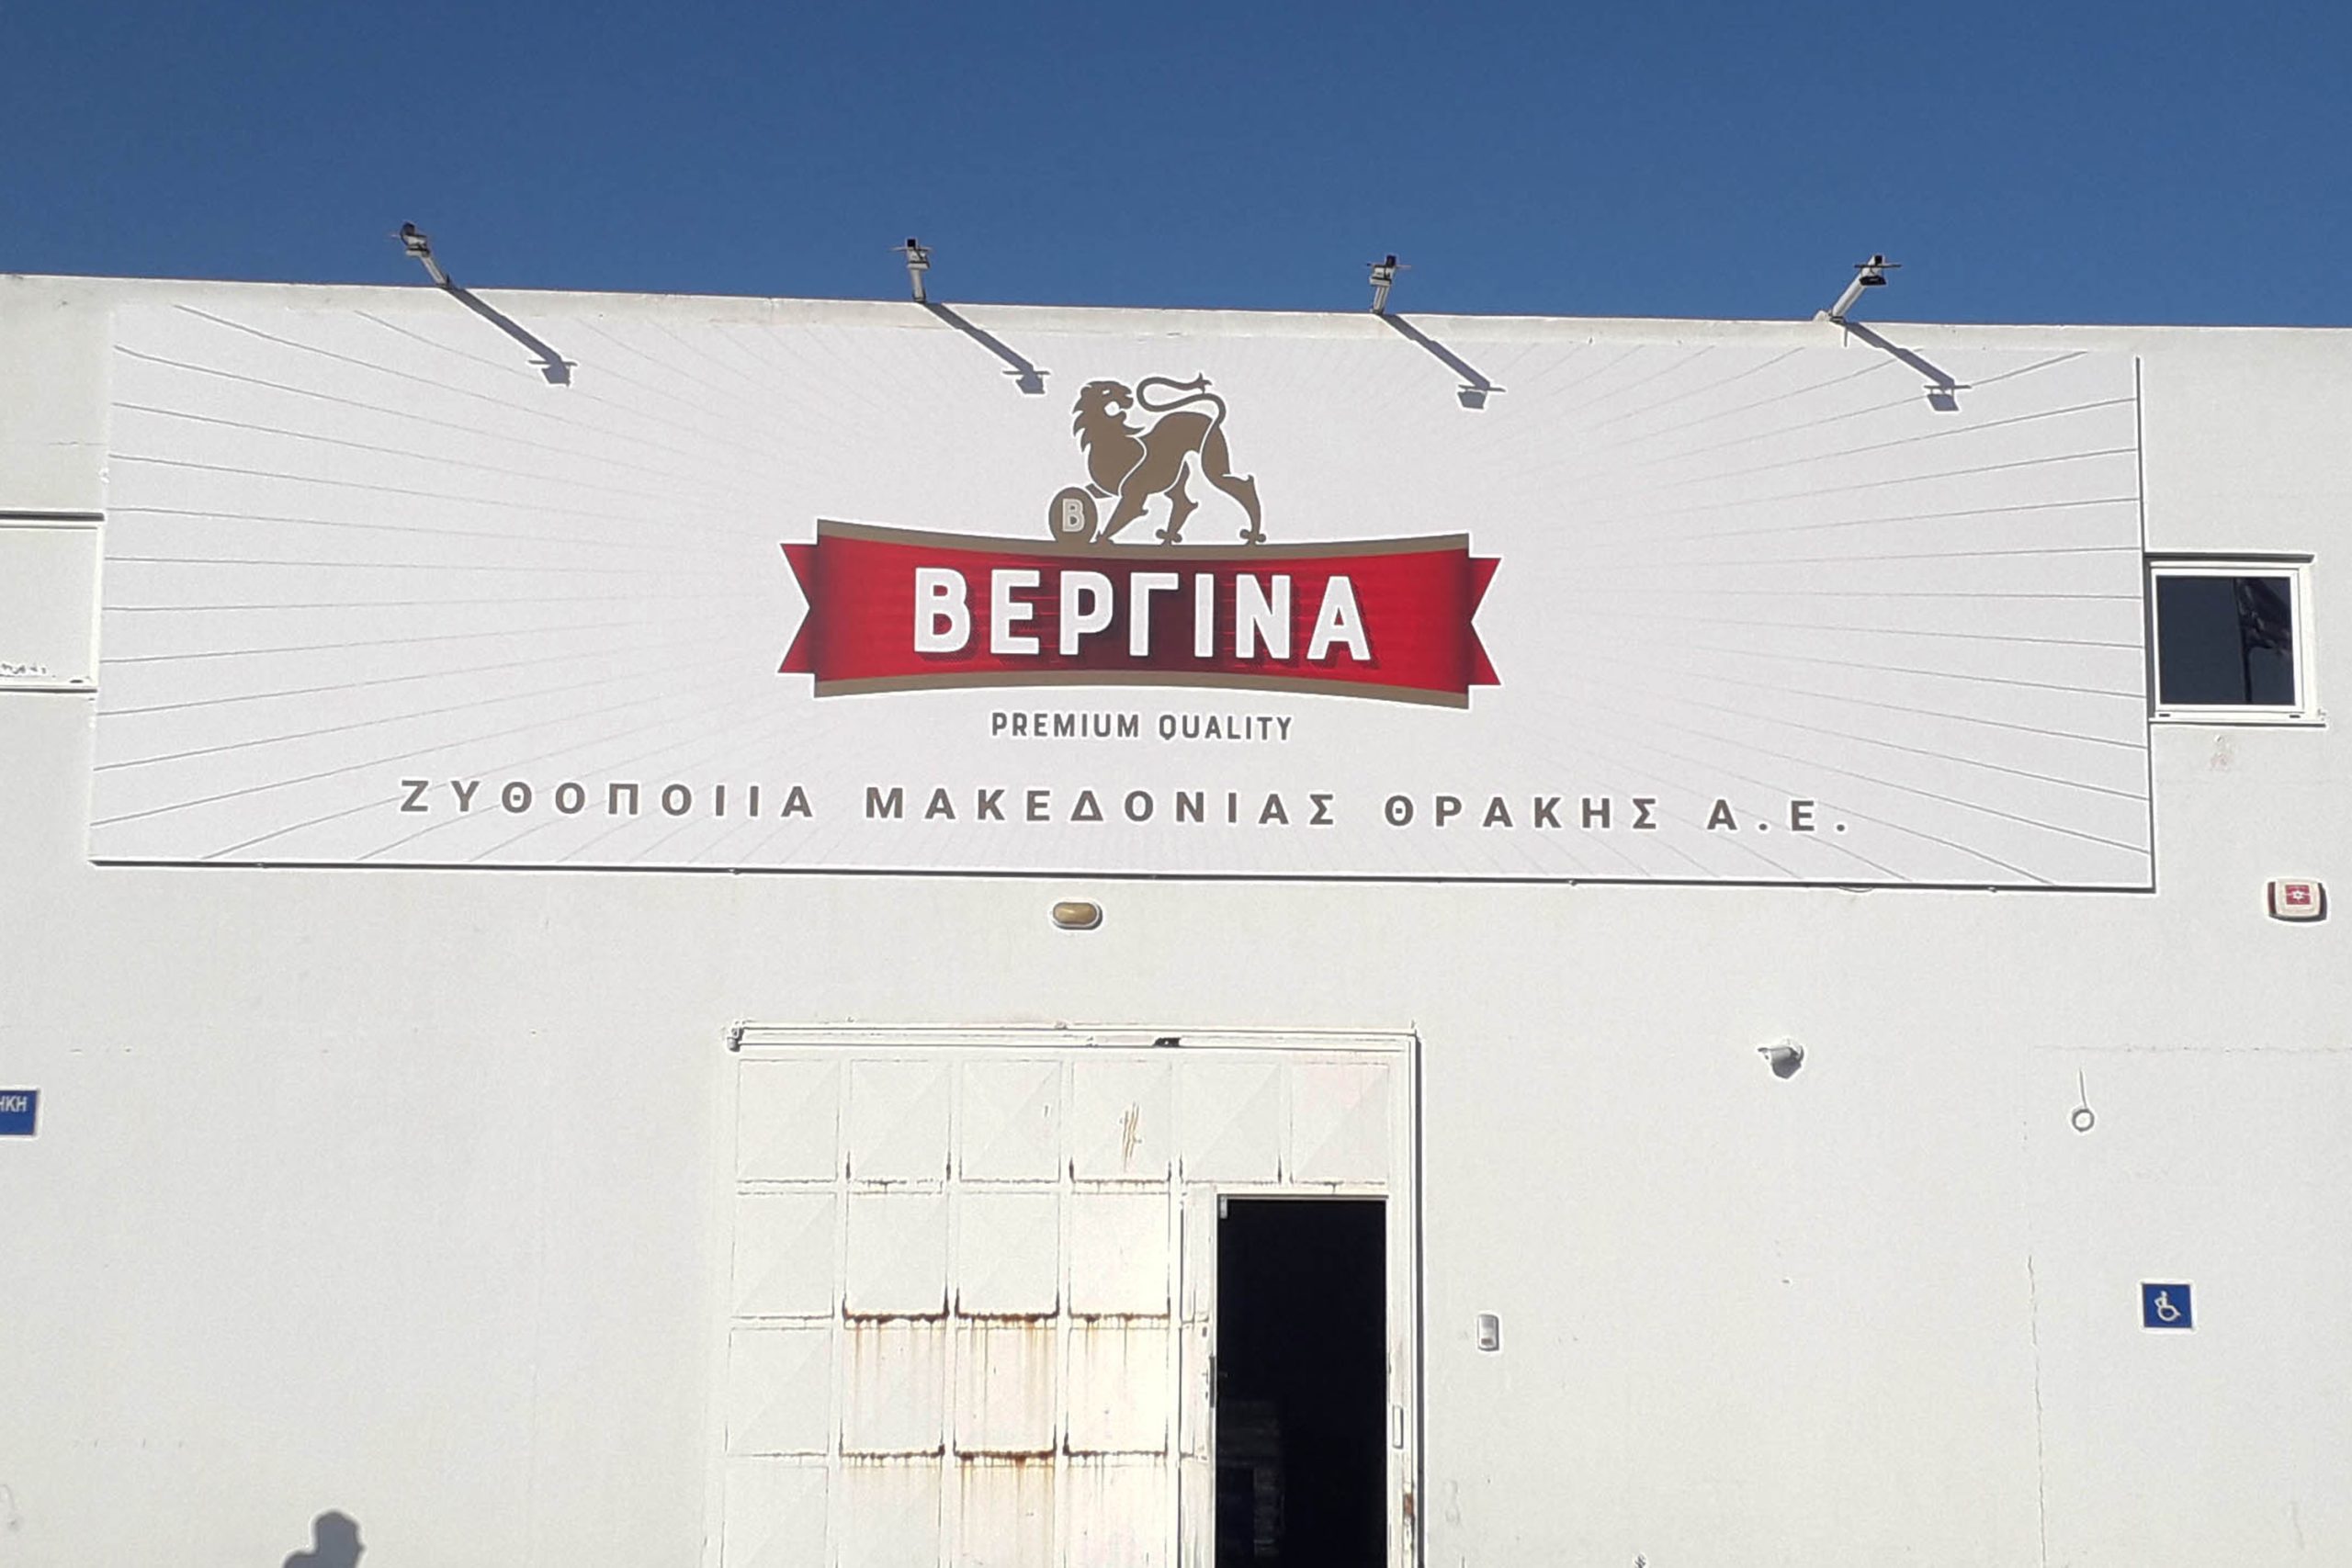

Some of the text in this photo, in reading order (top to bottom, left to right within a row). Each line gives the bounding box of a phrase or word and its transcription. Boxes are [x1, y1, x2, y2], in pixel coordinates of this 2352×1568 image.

[914, 567, 1371, 660] ΒΕΡΓΙΝΑ
[993, 712, 1291, 740] PREMIUM QUALITY
[401, 781, 812, 818] ΖΥΘΟΠΟΙΙΑ
[866, 786, 1333, 825] ΜΑΚΕΔΟΝΙΑΣ
[1385, 795, 1657, 829] ΘΡΑΚΗΣ
